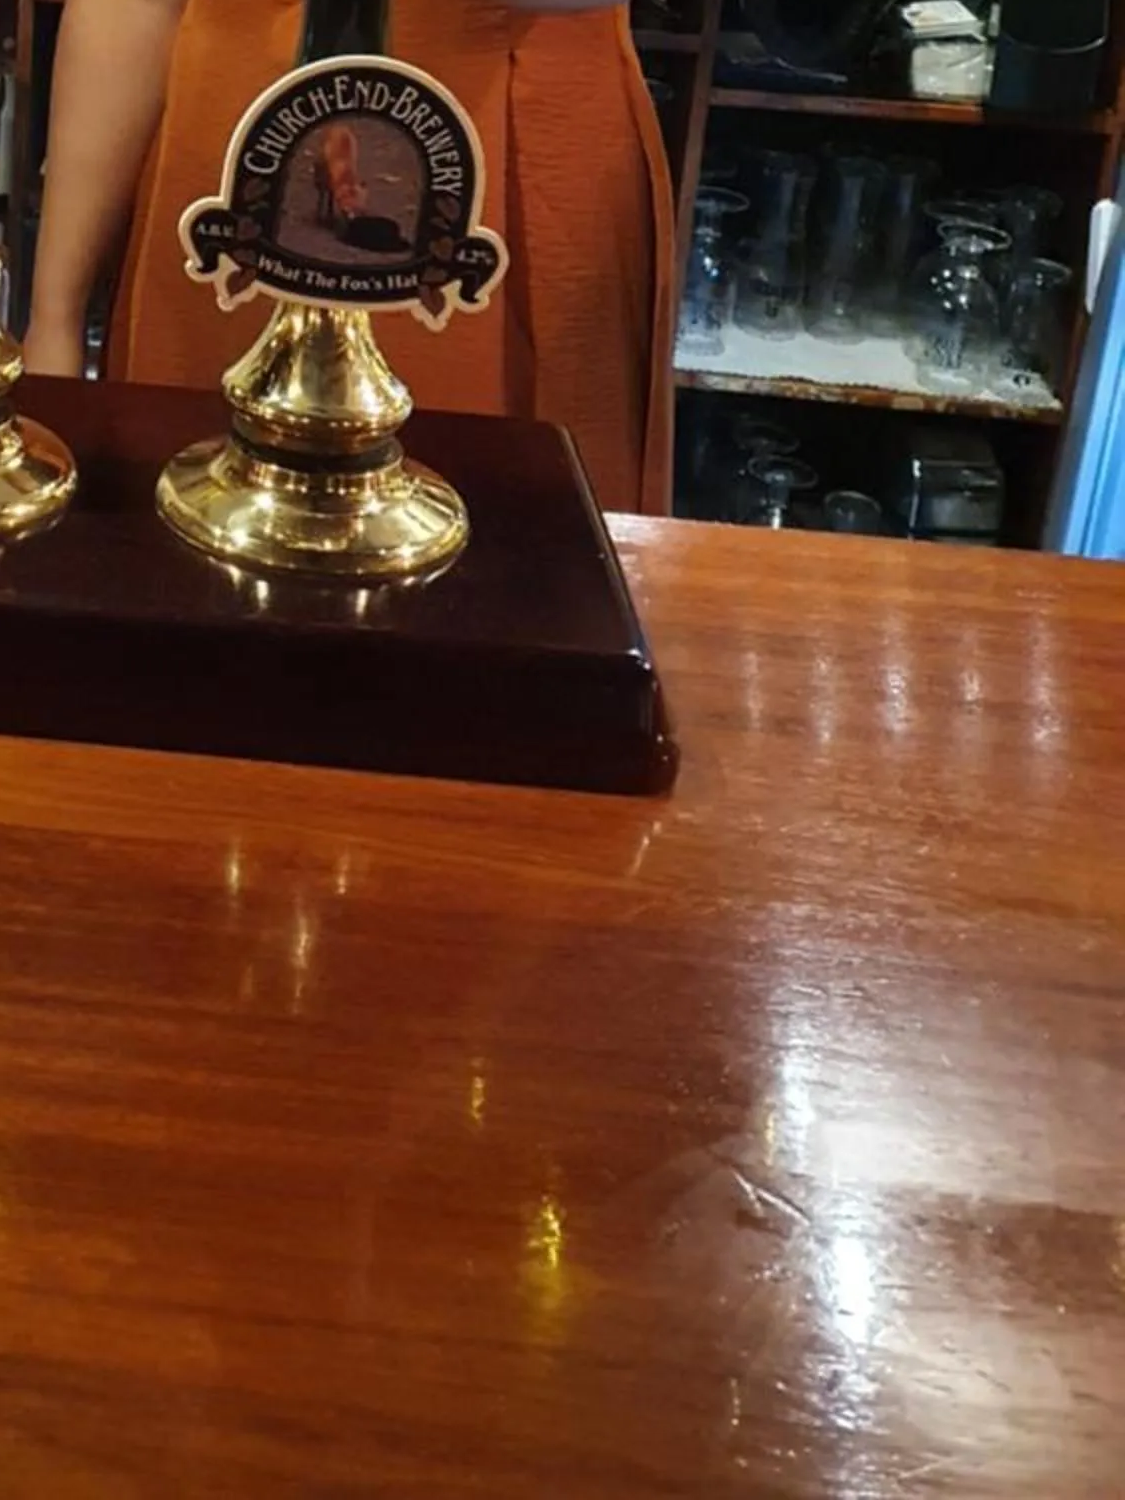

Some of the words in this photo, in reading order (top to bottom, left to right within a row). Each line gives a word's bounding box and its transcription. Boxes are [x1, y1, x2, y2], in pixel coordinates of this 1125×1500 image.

[243, 86, 331, 174] CHURCH
[334, 75, 390, 111] END
[390, 85, 464, 197] BREWERY
[258, 254, 300, 282] What
[305, 270, 337, 289] The
[340, 275, 383, 291] Fox's
[386, 274, 419, 290] Hat
